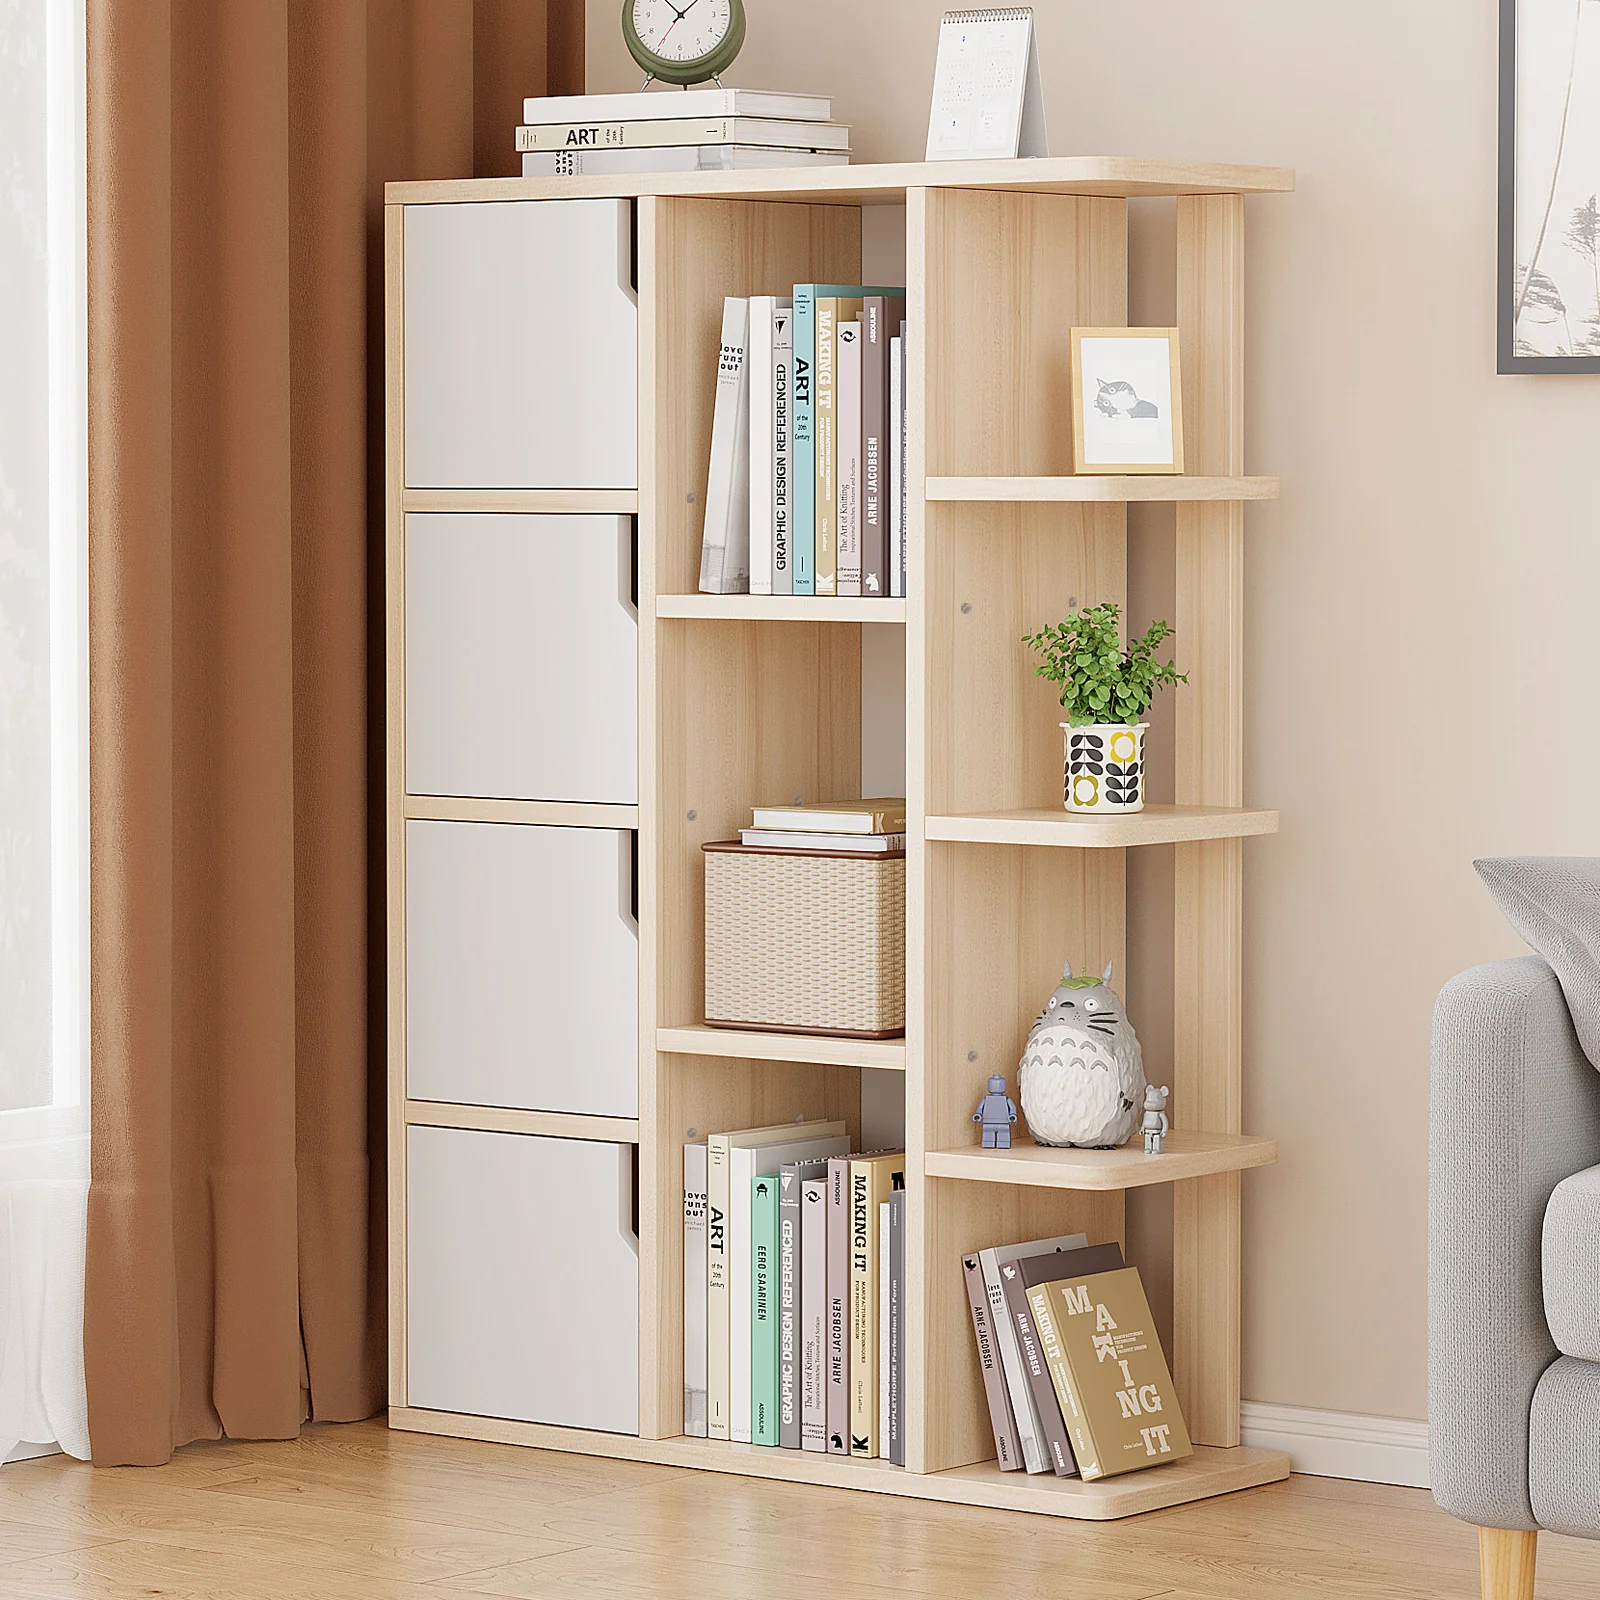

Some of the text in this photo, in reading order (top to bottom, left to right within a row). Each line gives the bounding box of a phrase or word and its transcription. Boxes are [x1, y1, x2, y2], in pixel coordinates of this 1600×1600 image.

[645, 11, 651, 19] 9
[649, 27, 655, 35] 8
[712, 11, 717, 19] 3
[696, 37, 701, 45] 5
[565, 128, 600, 146] ART
[720, 363, 739, 371] out
[795, 356, 810, 406] ART
[818, 310, 833, 409] MAKING IT
[794, 433, 810, 442] Century
[776, 363, 786, 570] GRAPHIC DESIGN REFERENCED
[868, 437, 878, 526] ARNE JACOBSEN
[840, 484, 850, 514] Knitting
[840, 515, 848, 524] of
[840, 525, 848, 538] Art
[685, 1209, 704, 1217] out
[710, 1205, 724, 1255] ART
[854, 1174, 867, 1272] MAKING IT
[709, 1280, 725, 1290] Century
[757, 1245, 767, 1321] EERO SAARINEN
[782, 1219, 793, 1308] REFERENCED
[782, 1311, 793, 1362] DESIGN
[832, 1298, 842, 1385] ARNE JACOBSEN
[974, 1306, 993, 1370] ARNE JACOBSEN
[1016, 1313, 1042, 1376] ARNE JACOBSEN
[1031, 1293, 1061, 1359] MAKING IT
[782, 1364, 793, 1425] GRAPHIC
[804, 1341, 815, 1409] The Art of Knitting
[999, 1435, 1009, 1462] ASSOULINE
[1139, 1424, 1171, 1457] IT
